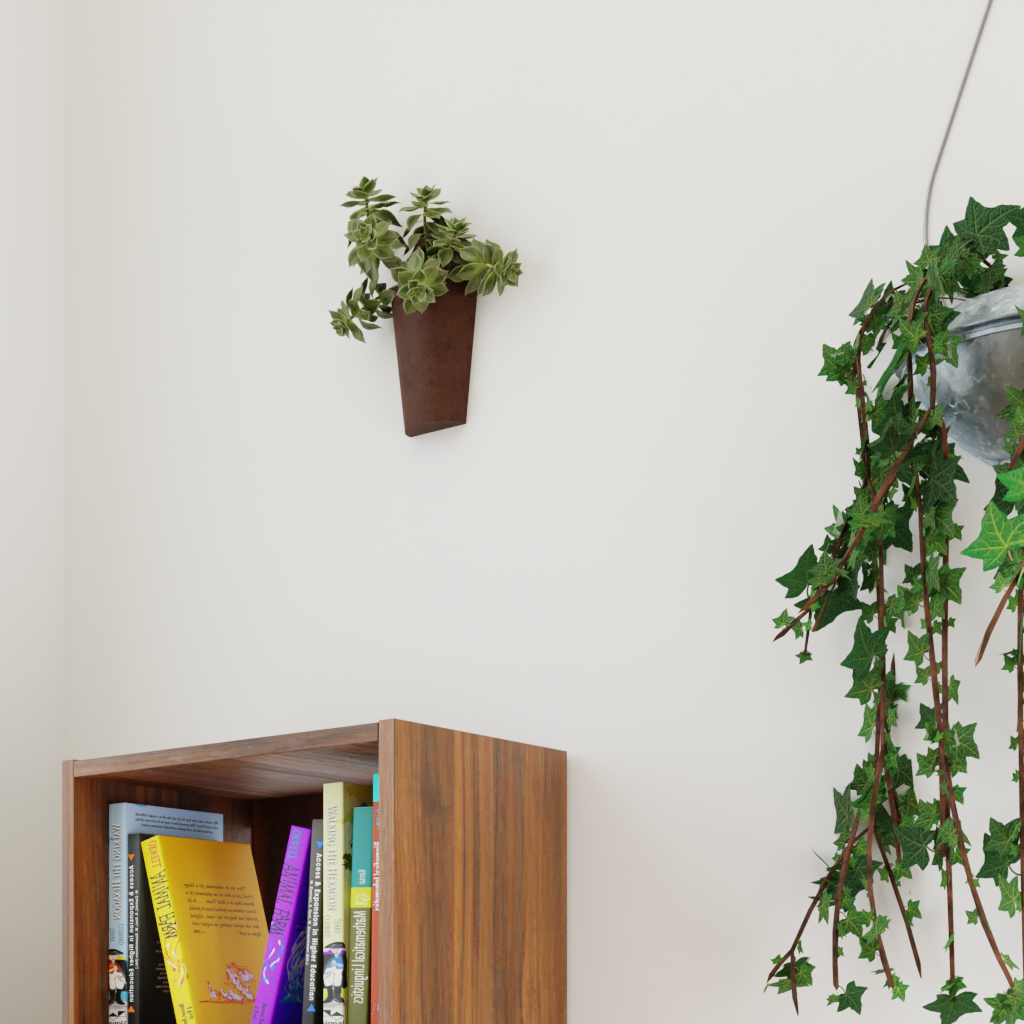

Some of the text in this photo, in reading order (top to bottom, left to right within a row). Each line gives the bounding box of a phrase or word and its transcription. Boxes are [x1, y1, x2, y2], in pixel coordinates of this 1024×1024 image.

[327, 804, 338, 911] WALKING THE HEXAGON
[270, 829, 302, 936] ORWELL ANIMAL FARM
[312, 888, 321, 926] Expansion
[310, 937, 318, 963] Higher
[308, 964, 317, 1001] Education
